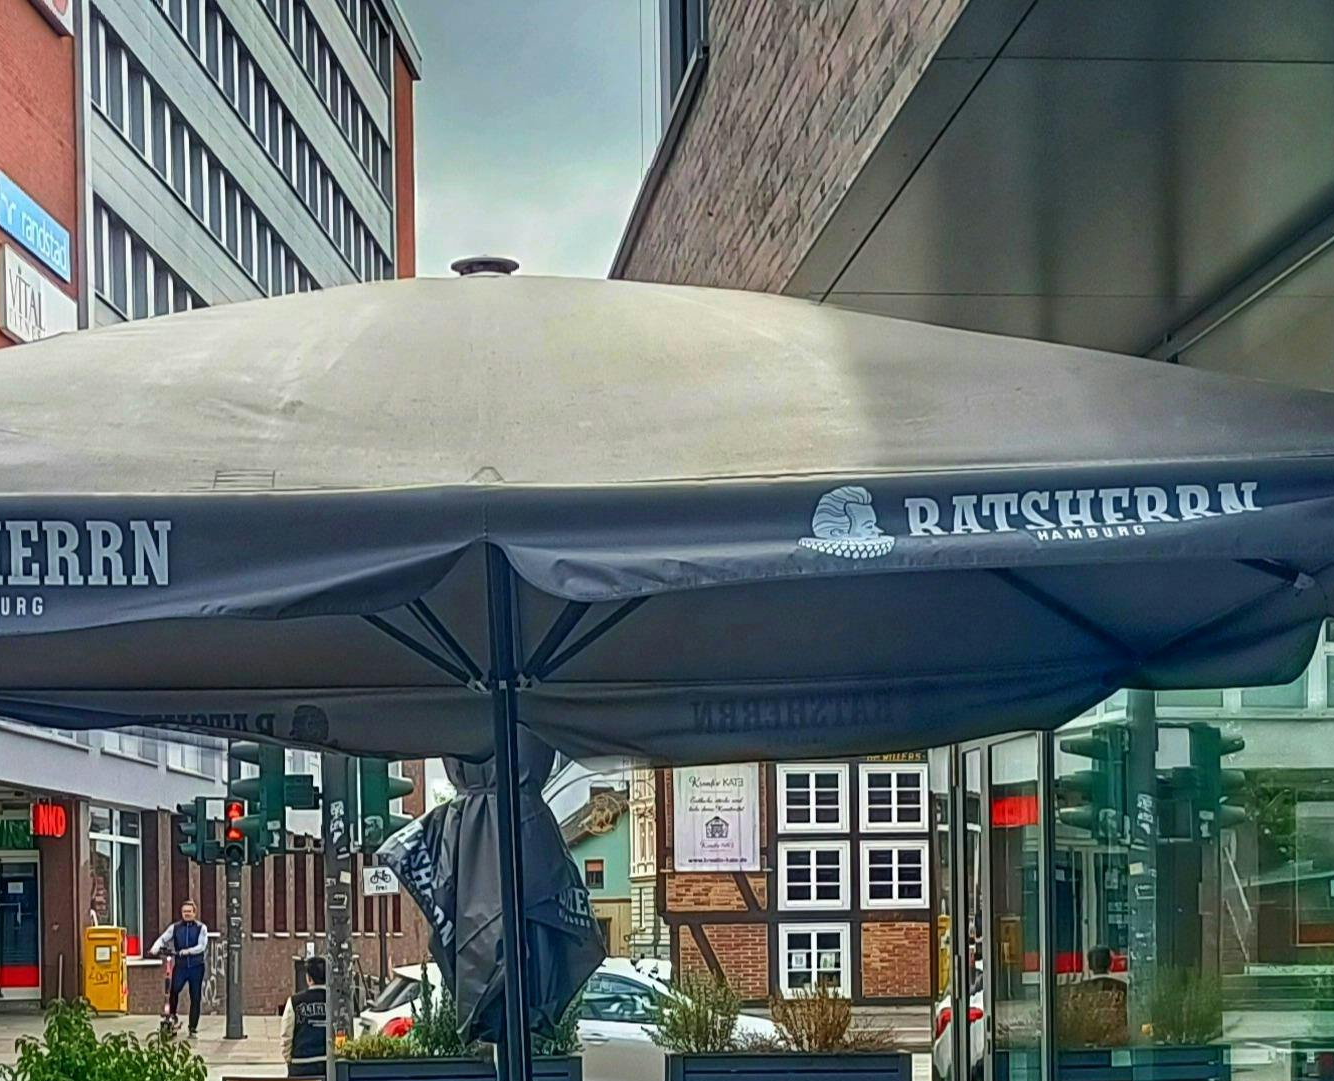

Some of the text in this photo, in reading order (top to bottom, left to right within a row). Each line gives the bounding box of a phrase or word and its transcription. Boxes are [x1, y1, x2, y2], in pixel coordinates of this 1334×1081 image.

[20, 212, 67, 270] randstad
[904, 482, 1263, 537] RATSHERRN
[1037, 523, 1147, 542] HAMBURG
[36, 804, 66, 838] NKD
